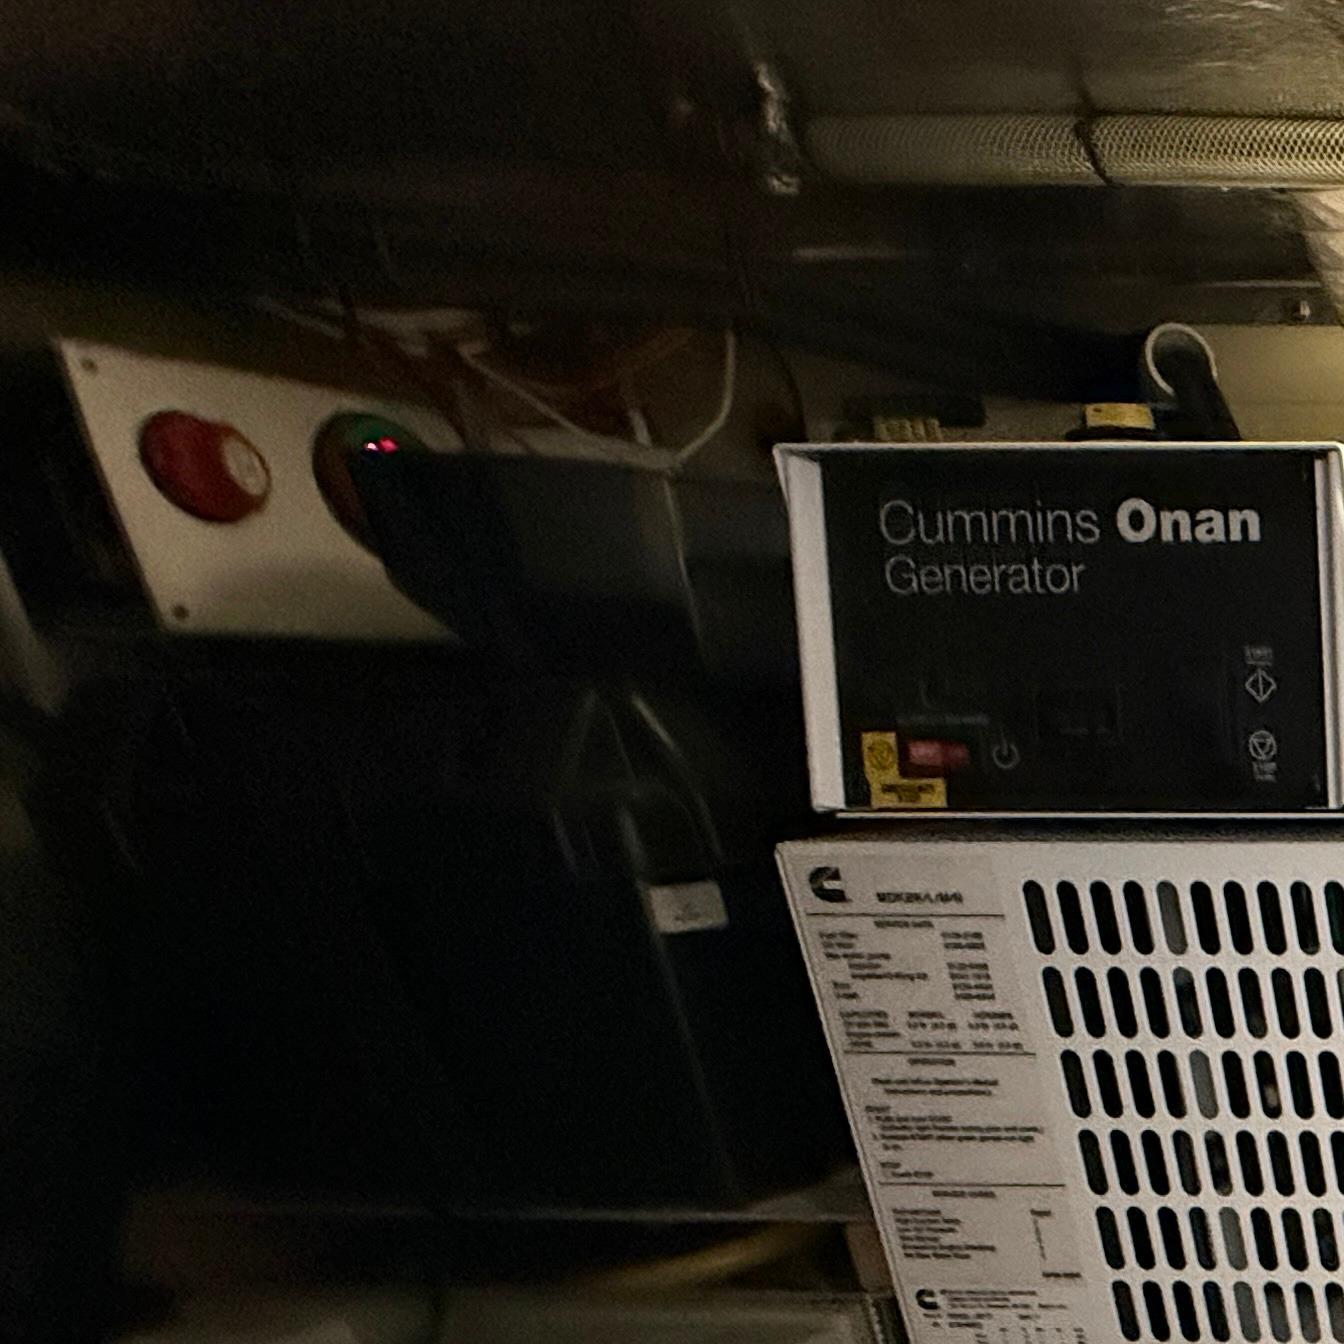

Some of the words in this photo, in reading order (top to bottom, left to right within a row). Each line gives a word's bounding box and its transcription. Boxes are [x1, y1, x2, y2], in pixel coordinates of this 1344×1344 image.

[878, 498, 1102, 546] Cummins
[1115, 497, 1262, 544] Onan
[884, 555, 1087, 596] Generator
